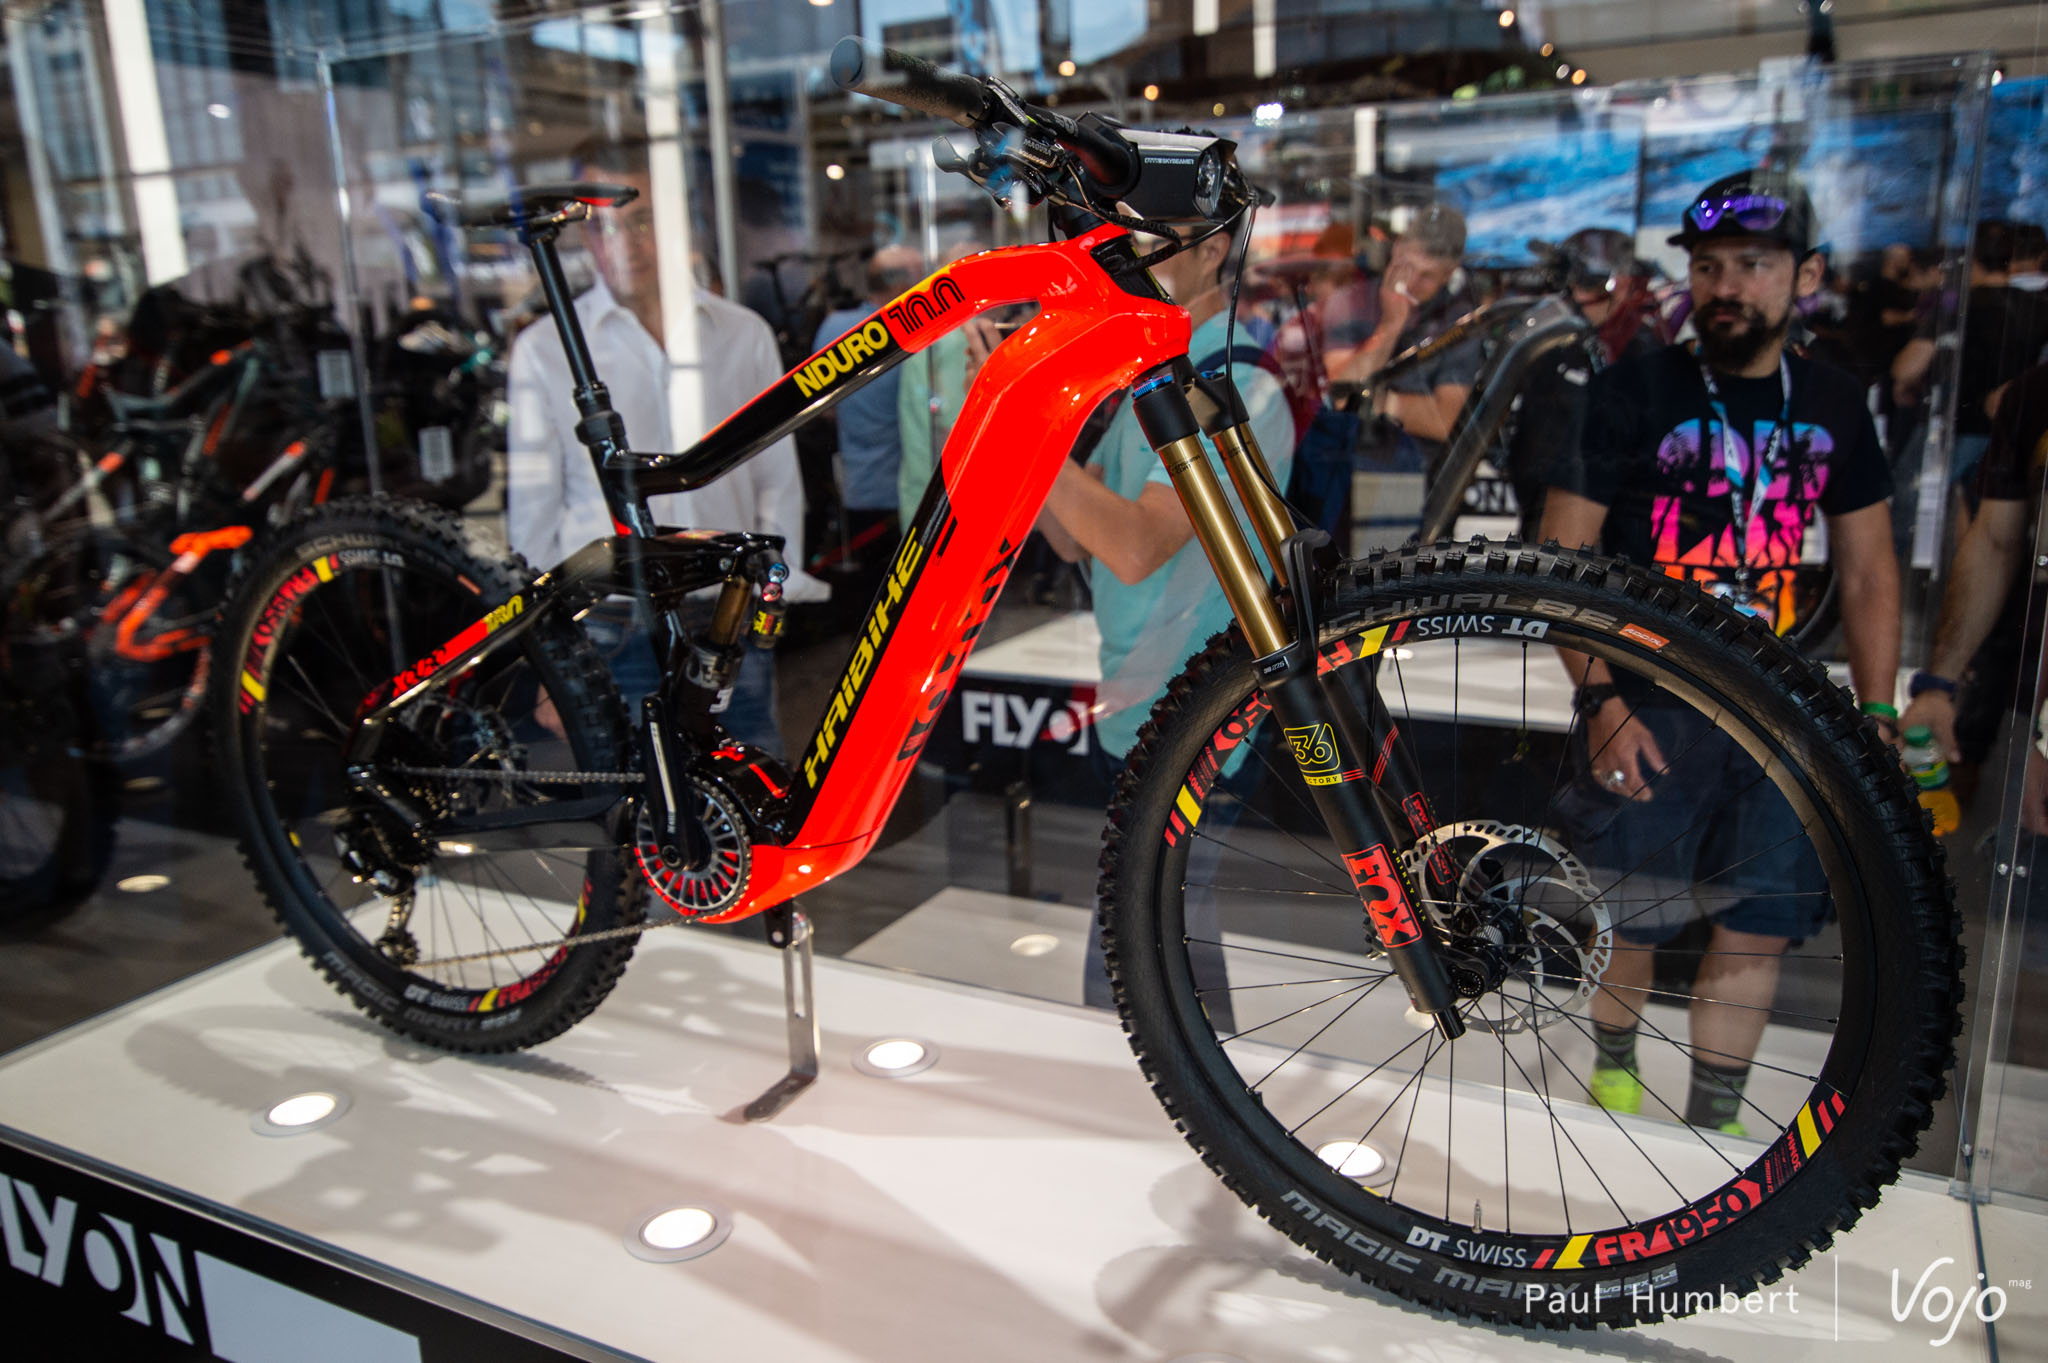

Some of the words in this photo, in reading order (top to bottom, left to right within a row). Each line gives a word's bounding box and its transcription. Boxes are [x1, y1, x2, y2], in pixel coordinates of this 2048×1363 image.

[792, 320, 889, 399] NDURO
[1416, 616, 1493, 637] SWISS
[1502, 621, 1550, 638] DT
[1347, 847, 1419, 945] FOX
[1281, 1190, 1422, 1274] MAGIC
[1433, 1267, 1582, 1302] MARY
[1405, 1225, 1450, 1251] DT
[1453, 1239, 1527, 1268] SWISS
